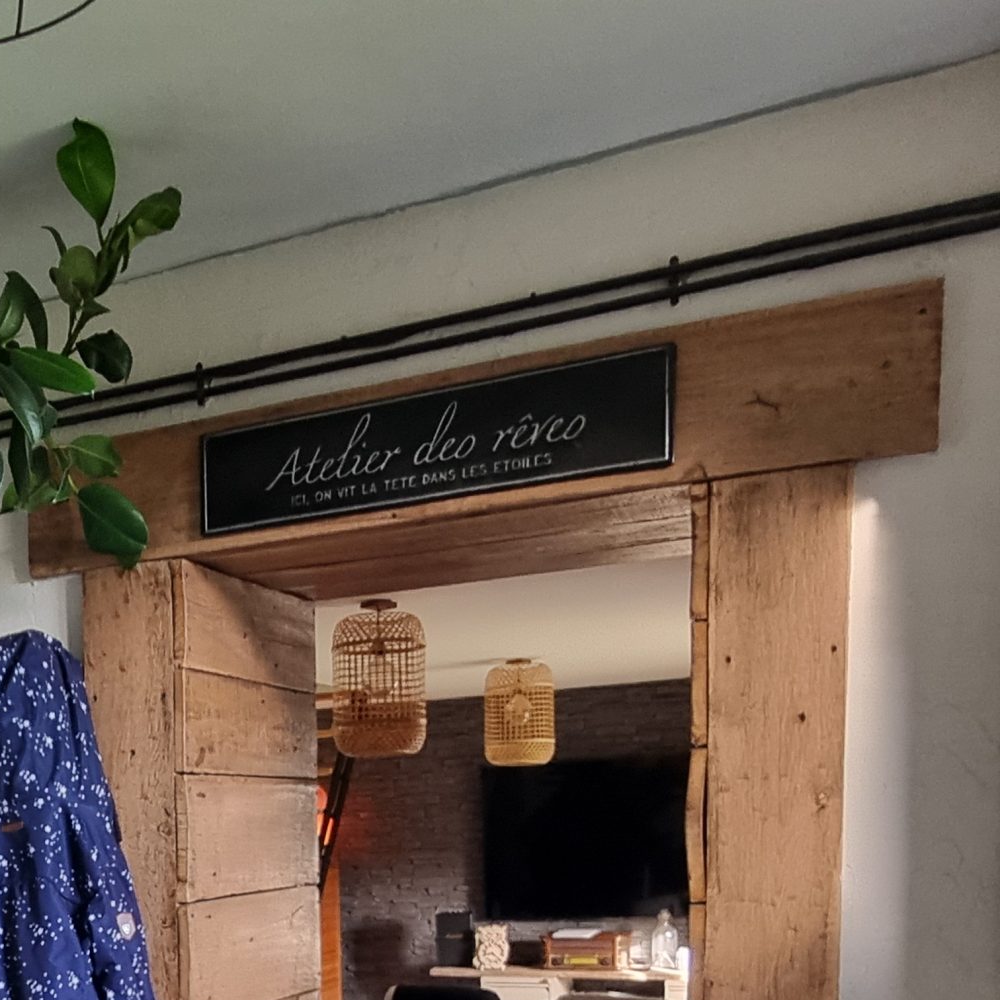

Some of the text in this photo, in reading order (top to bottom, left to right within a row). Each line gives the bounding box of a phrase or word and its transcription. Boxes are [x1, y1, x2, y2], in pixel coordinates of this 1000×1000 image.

[265, 412, 401, 491] Atelier
[492, 412, 587, 452] rêves
[314, 490, 332, 504] ON
[337, 485, 356, 499] VIT
[361, 482, 378, 496] LA
[422, 468, 457, 486] DANS
[462, 463, 488, 479] LES
